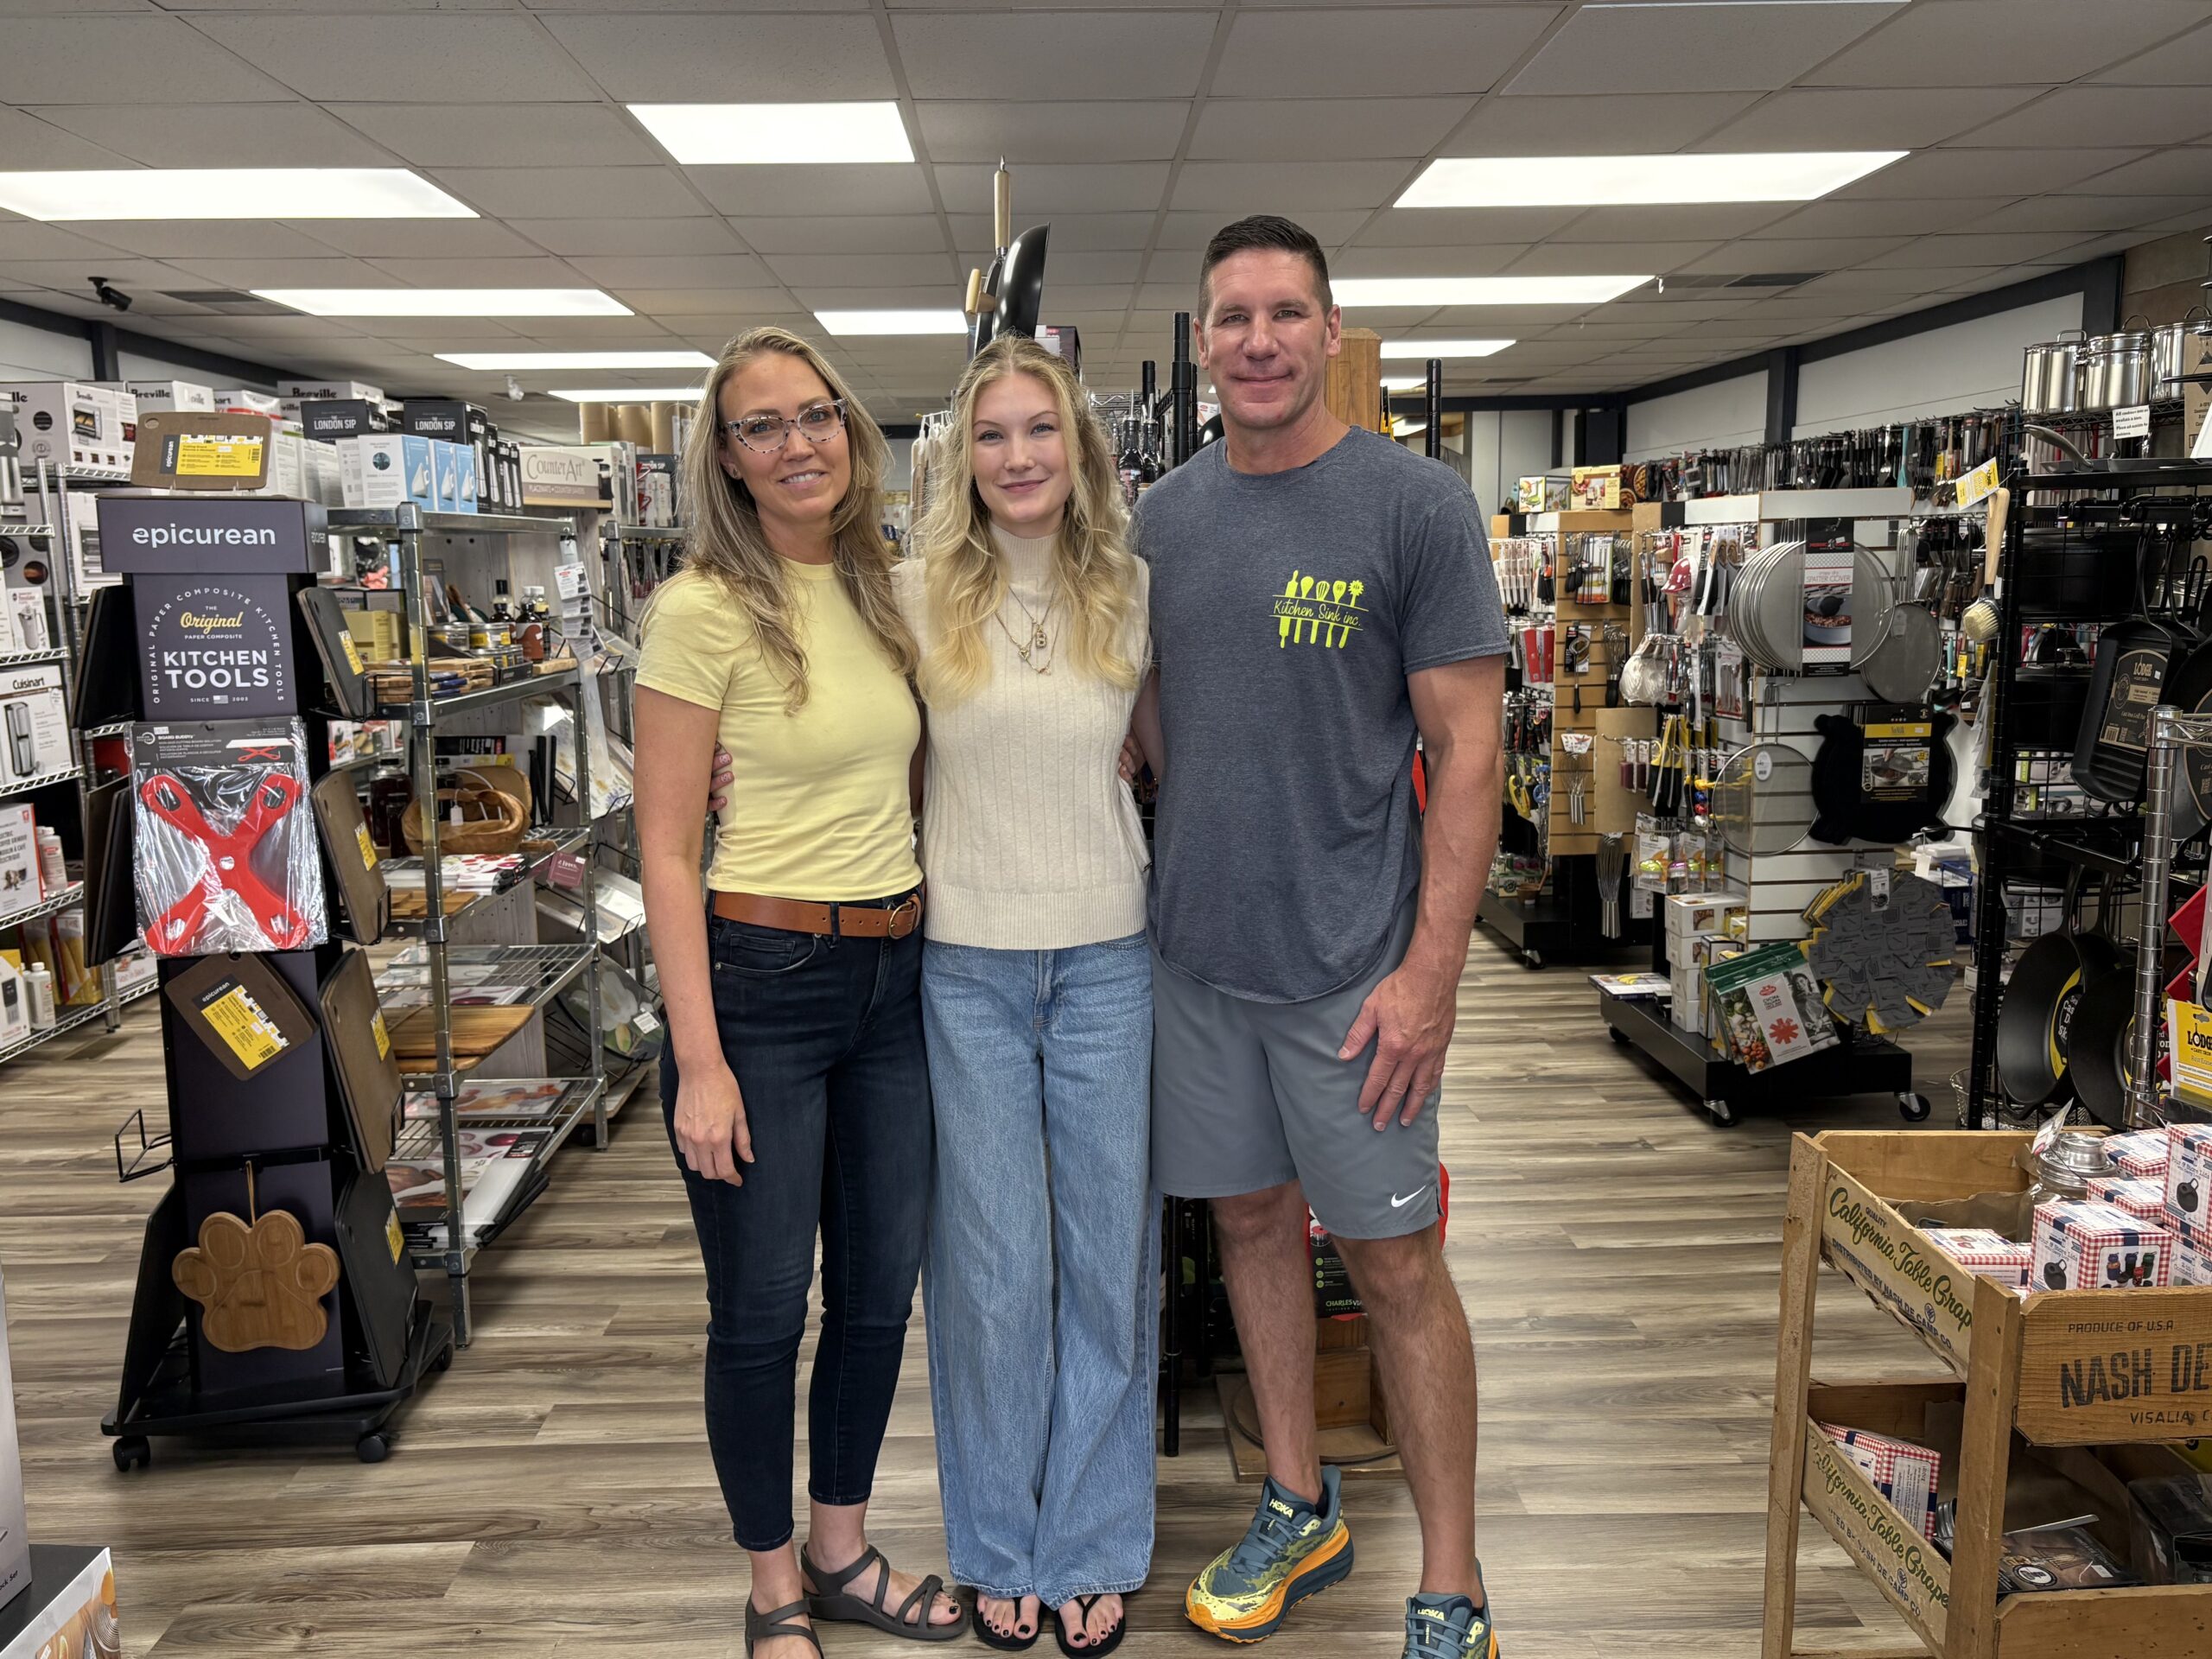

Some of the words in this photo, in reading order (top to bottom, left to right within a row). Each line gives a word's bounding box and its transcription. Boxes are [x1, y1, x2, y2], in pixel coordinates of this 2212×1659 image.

[130, 389, 171, 398] Breville
[281, 403, 300, 411] ville
[314, 419, 344, 430] LONDON
[345, 419, 357, 429] SIP
[416, 421, 442, 431] LONDON
[443, 421, 455, 431] SIP
[132, 523, 276, 548] epicurean
[176, 588, 251, 605] COMPOSITE
[149, 602, 172, 637] PAPER
[1274, 599, 1313, 617] Kitchen
[1318, 603, 1340, 621] Sink
[180, 611, 244, 634] Original
[255, 607, 281, 656] KITCHEN
[163, 650, 268, 667] KITCHEN
[13, 677, 45, 690] Cuisinart
[149, 645, 161, 704] ORIGINAL
[164, 667, 270, 689] TOOLS
[275, 663, 284, 701] TOOLS
[202, 982, 230, 1002] epicurean
[2063, 1000, 2075, 1015] Cas
[2187, 1028, 2212, 1051] LODG
[1866, 1207, 1887, 1228] QUALITY
[1829, 1187, 1895, 1261] California
[1893, 1242, 1932, 1293] Table
[1932, 1274, 1972, 1332] Grap
[1832, 1238, 1873, 1279] DISTRIBUTED
[1873, 1274, 1883, 1287] BY
[1884, 1284, 1903, 1310] NASH
[1904, 1302, 1915, 1316] DE
[1916, 1313, 1939, 1338] CAMP
[2068, 1321, 2124, 1333] PRODUCE
[2127, 1320, 2144, 1332] OF
[2061, 1348, 2152, 1408] NASH
[2171, 1342, 2212, 1393] DE
[1268, 1498, 1294, 1518] HOKA
[1813, 1446, 1867, 1520] lifornia
[1866, 1504, 1904, 1559] Table
[1904, 1545, 1948, 1609] Grape
[1877, 1562, 1887, 1579] DE
[1888, 1575, 1909, 1603] CAMP
